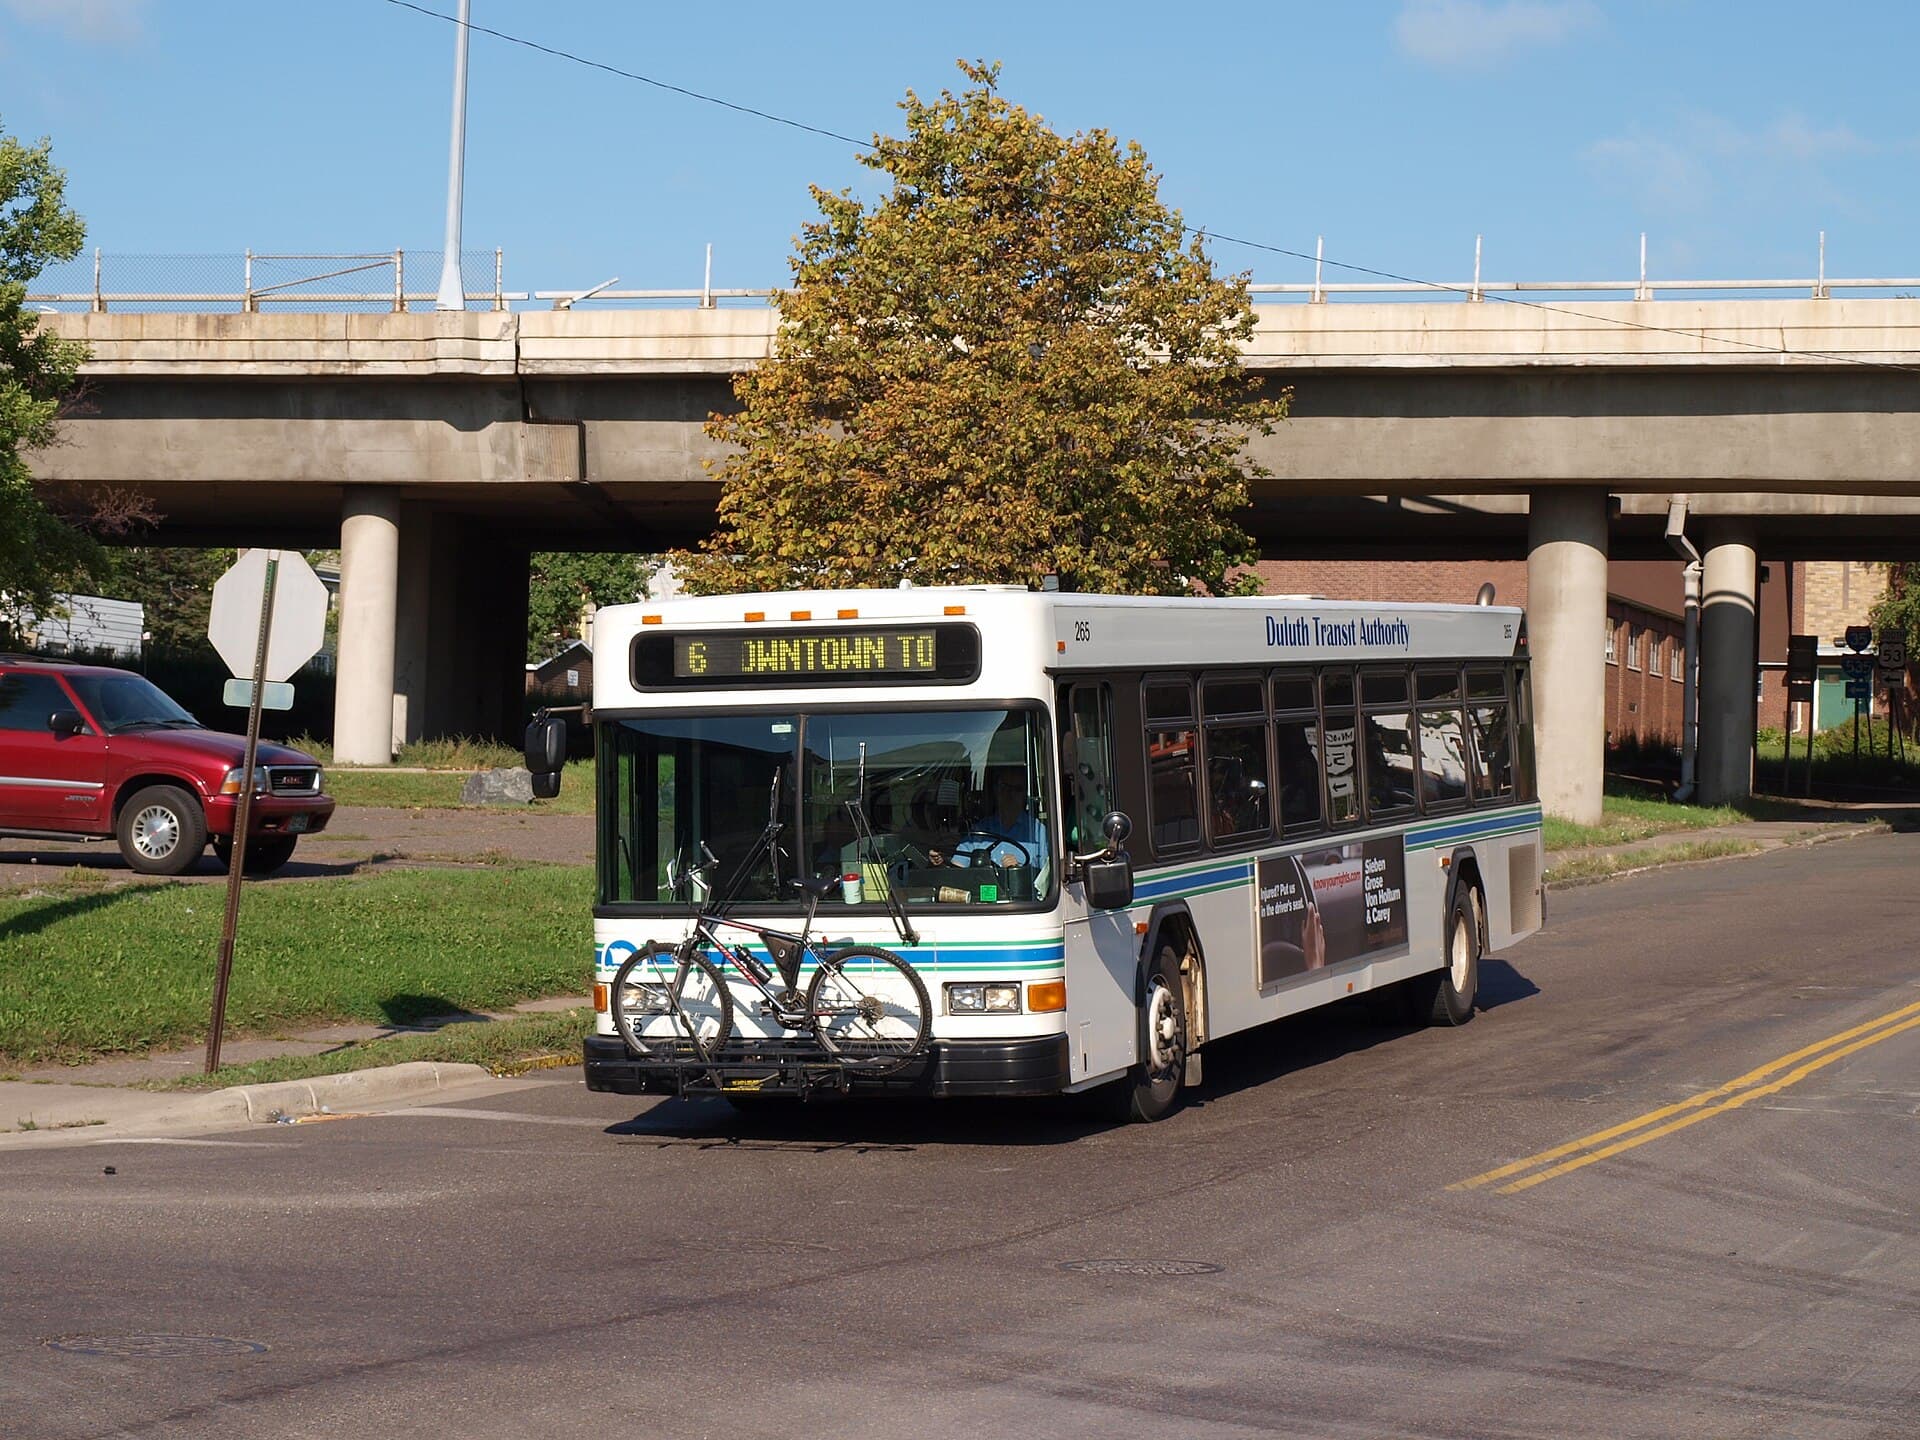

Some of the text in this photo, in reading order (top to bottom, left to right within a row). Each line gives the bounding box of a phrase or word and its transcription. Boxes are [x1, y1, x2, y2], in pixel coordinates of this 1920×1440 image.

[1074, 621, 1090, 641] 265
[1265, 616, 1410, 651] Duluth Transit Authority
[688, 643, 707, 673] 6
[897, 635, 933, 668] TO
[1883, 649, 1901, 662] 53
[1846, 660, 1873, 673] 535
[1364, 857, 1386, 875] Sieben
[1364, 875, 1384, 892] Grose
[1365, 892, 1378, 908] Von
[1266, 903, 1275, 917] the
[1366, 907, 1391, 925] & Carey
